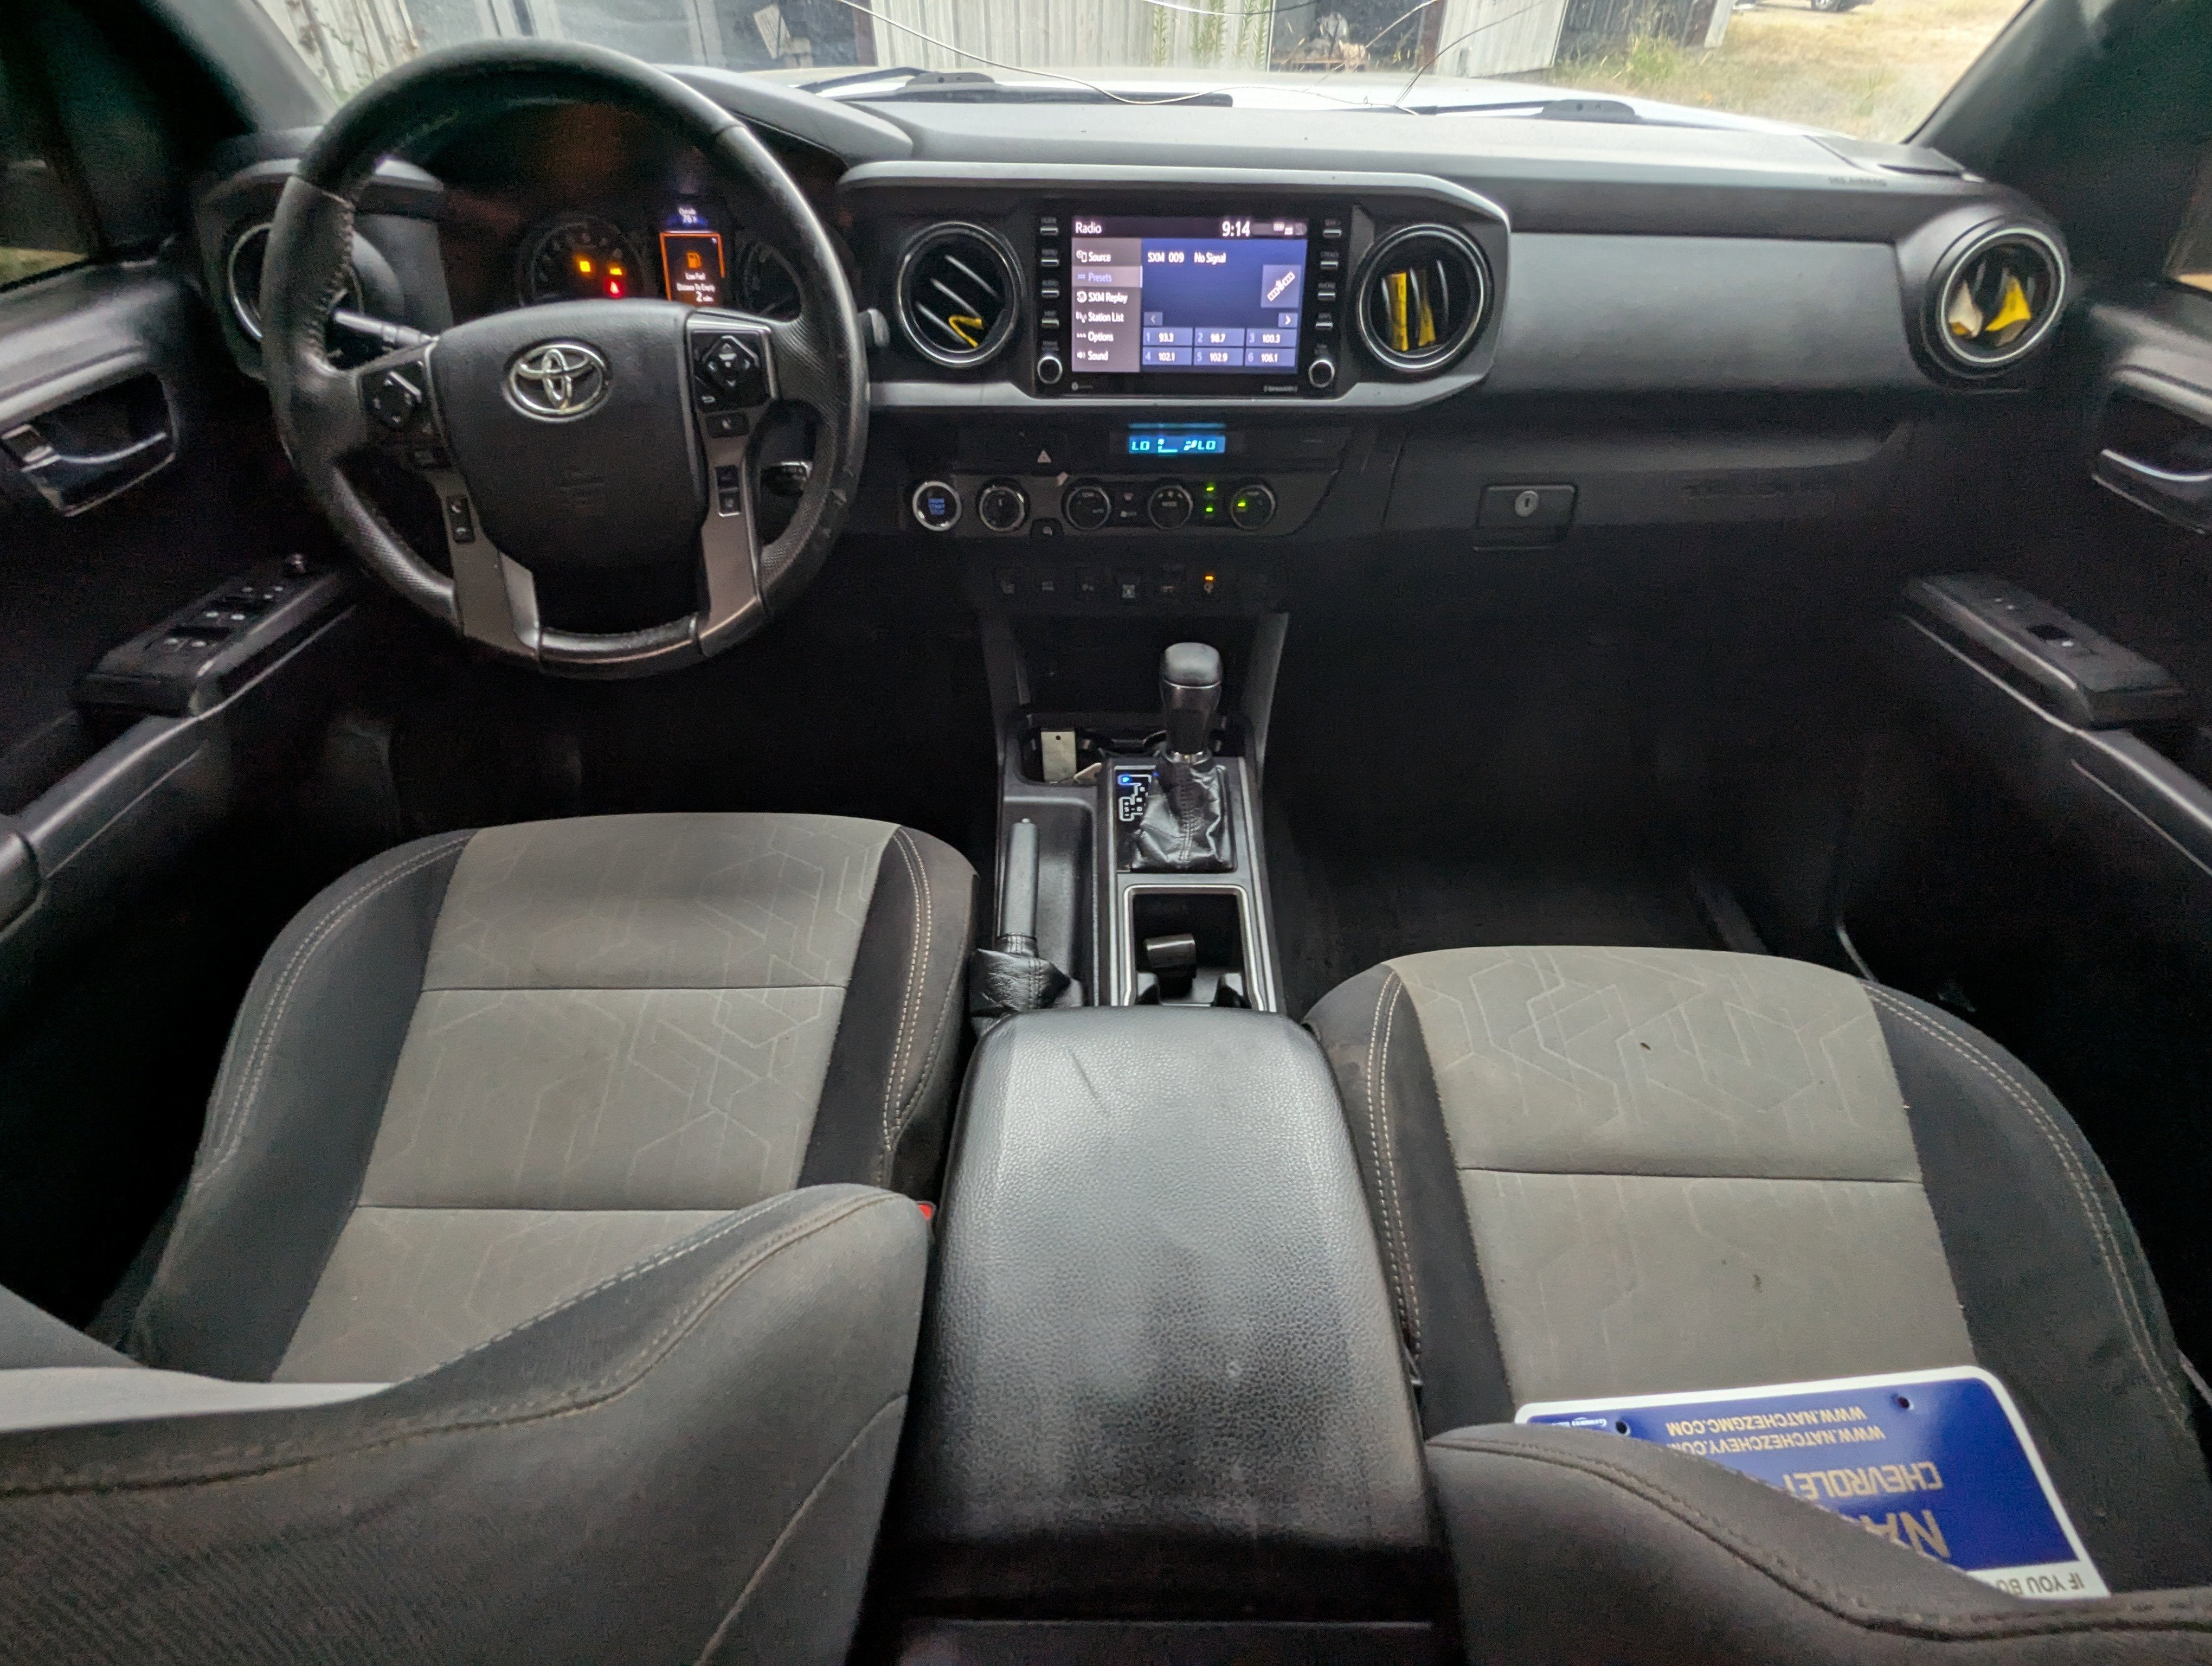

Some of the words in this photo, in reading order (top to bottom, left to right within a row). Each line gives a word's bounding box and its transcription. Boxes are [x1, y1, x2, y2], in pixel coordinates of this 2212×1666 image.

[1075, 221, 1102, 234] Radio
[1221, 220, 1250, 237] 9:14
[1088, 251, 1111, 262] Source
[1147, 252, 1165, 262] SXM
[1168, 252, 1185, 263] 009
[1194, 252, 1205, 263] No
[1206, 252, 1226, 265] Signal
[1088, 272, 1112, 283] Presets
[696, 291, 703, 302] 2
[1088, 292, 1105, 303] SXM
[1105, 292, 1128, 304] Replay
[1088, 311, 1111, 322] Station
[1111, 312, 1124, 322] List
[1088, 331, 1114, 343] Options
[1146, 331, 1150, 343] 1
[1198, 332, 1204, 343] 2
[1249, 333, 1255, 344] 3
[1262, 334, 1281, 344] 100.3
[1088, 350, 1109, 361] Sound
[1145, 351, 1152, 362] 4
[1158, 352, 1175, 362] 102.1
[1197, 352, 1203, 363] 5
[1210, 353, 1229, 363] 102.9
[1248, 353, 1254, 363] 6
[1131, 441, 1150, 451] LO
[1197, 440, 1217, 451] LO
[1666, 1406, 1868, 1437] WWW.NATCHEZGMC.COM
[2025, 1574, 2067, 1593] YOU
[2068, 1572, 2085, 1591] IF
